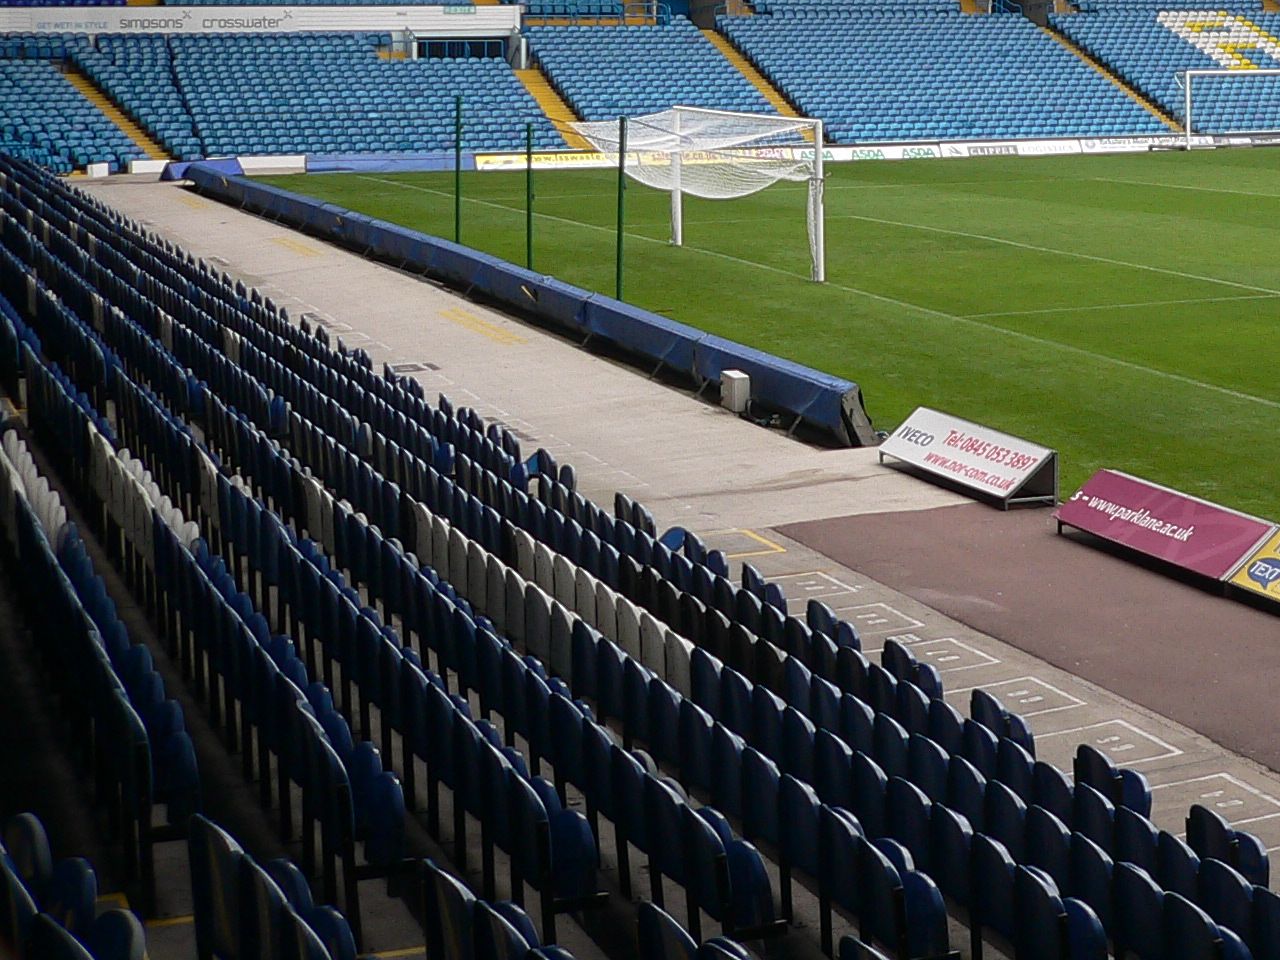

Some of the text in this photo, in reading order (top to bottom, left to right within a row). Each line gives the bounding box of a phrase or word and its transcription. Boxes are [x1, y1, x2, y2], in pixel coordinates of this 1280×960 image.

[119, 16, 183, 30] simpsons
[202, 16, 283, 29] crosswater
[851, 148, 886, 160] ASDA
[902, 147, 937, 159] ASDA
[897, 425, 935, 447] IVECO
[961, 437, 985, 457] 0845
[986, 446, 1010, 463] 053
[1004, 453, 1038, 471] 3897
[1088, 496, 1193, 541] www.parklane.ac.uk
